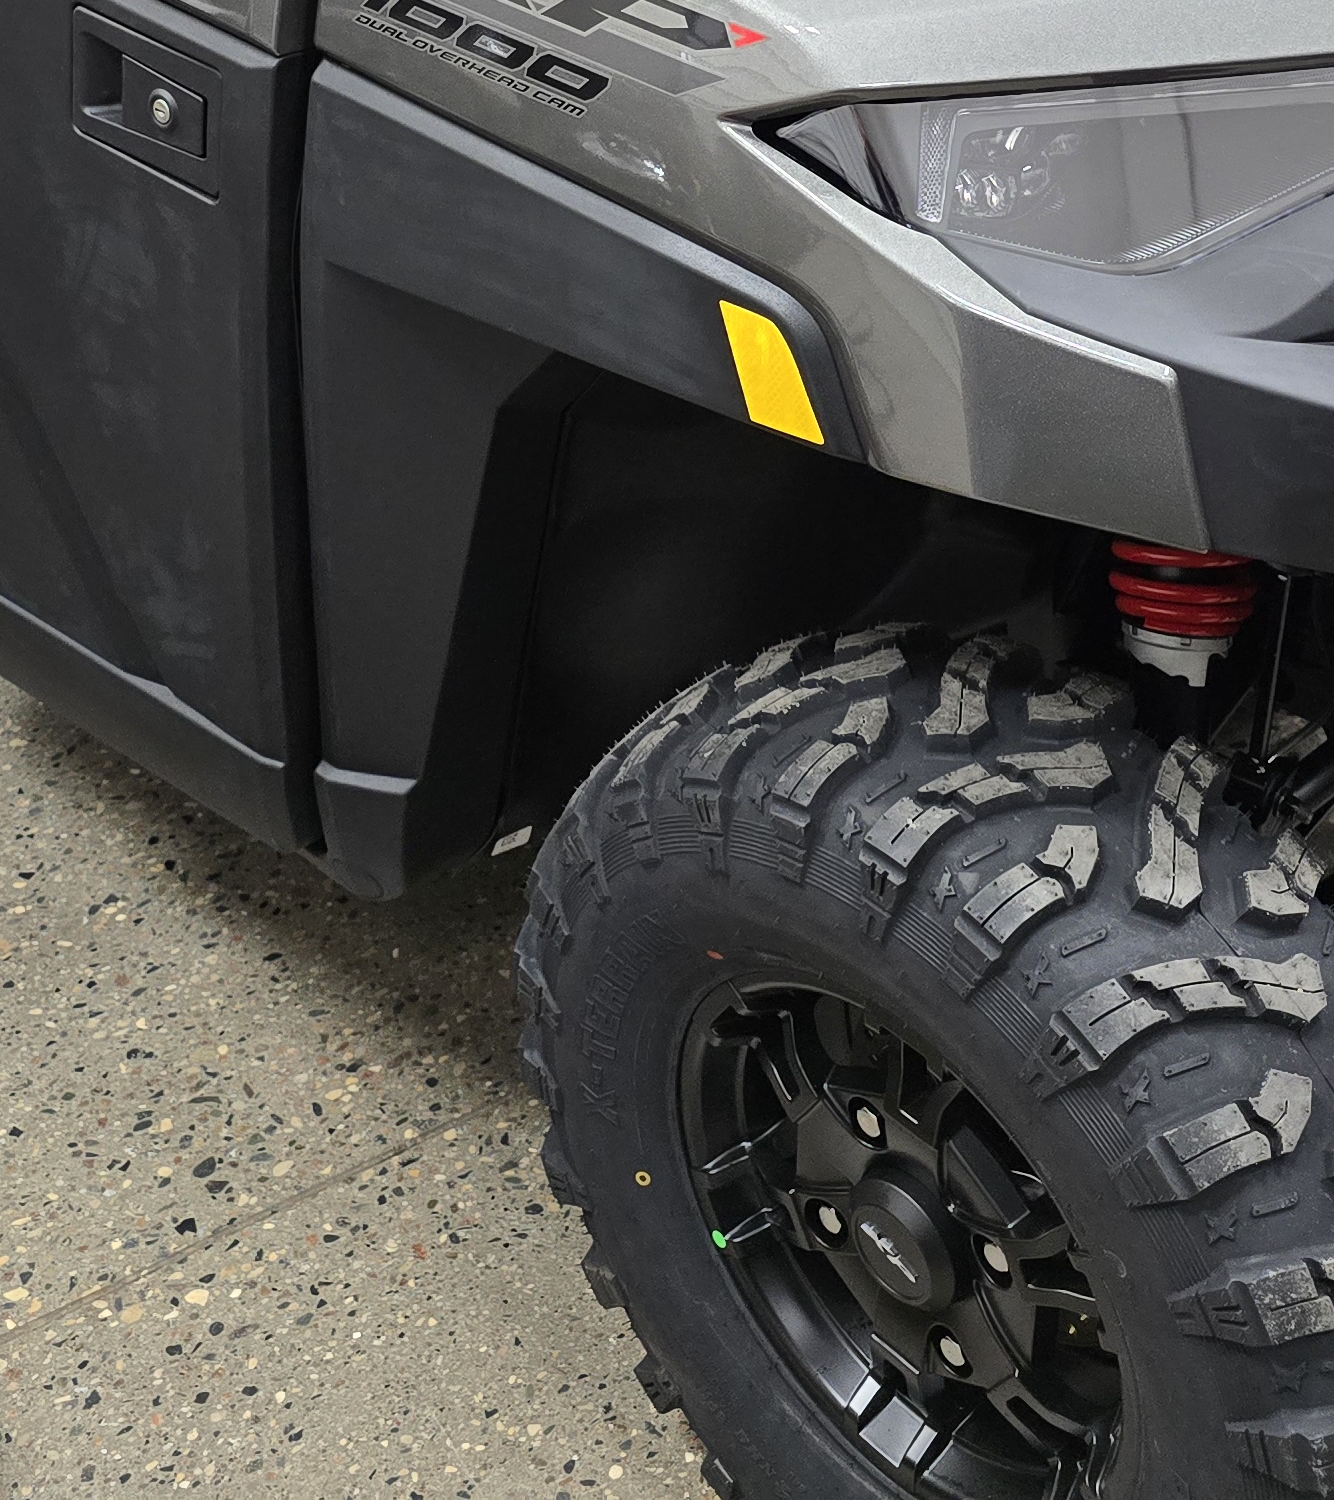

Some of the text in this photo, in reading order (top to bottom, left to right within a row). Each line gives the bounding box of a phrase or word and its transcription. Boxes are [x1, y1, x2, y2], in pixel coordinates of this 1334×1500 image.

[354, 13, 587, 118] DUAL OVERHEAD CAM
